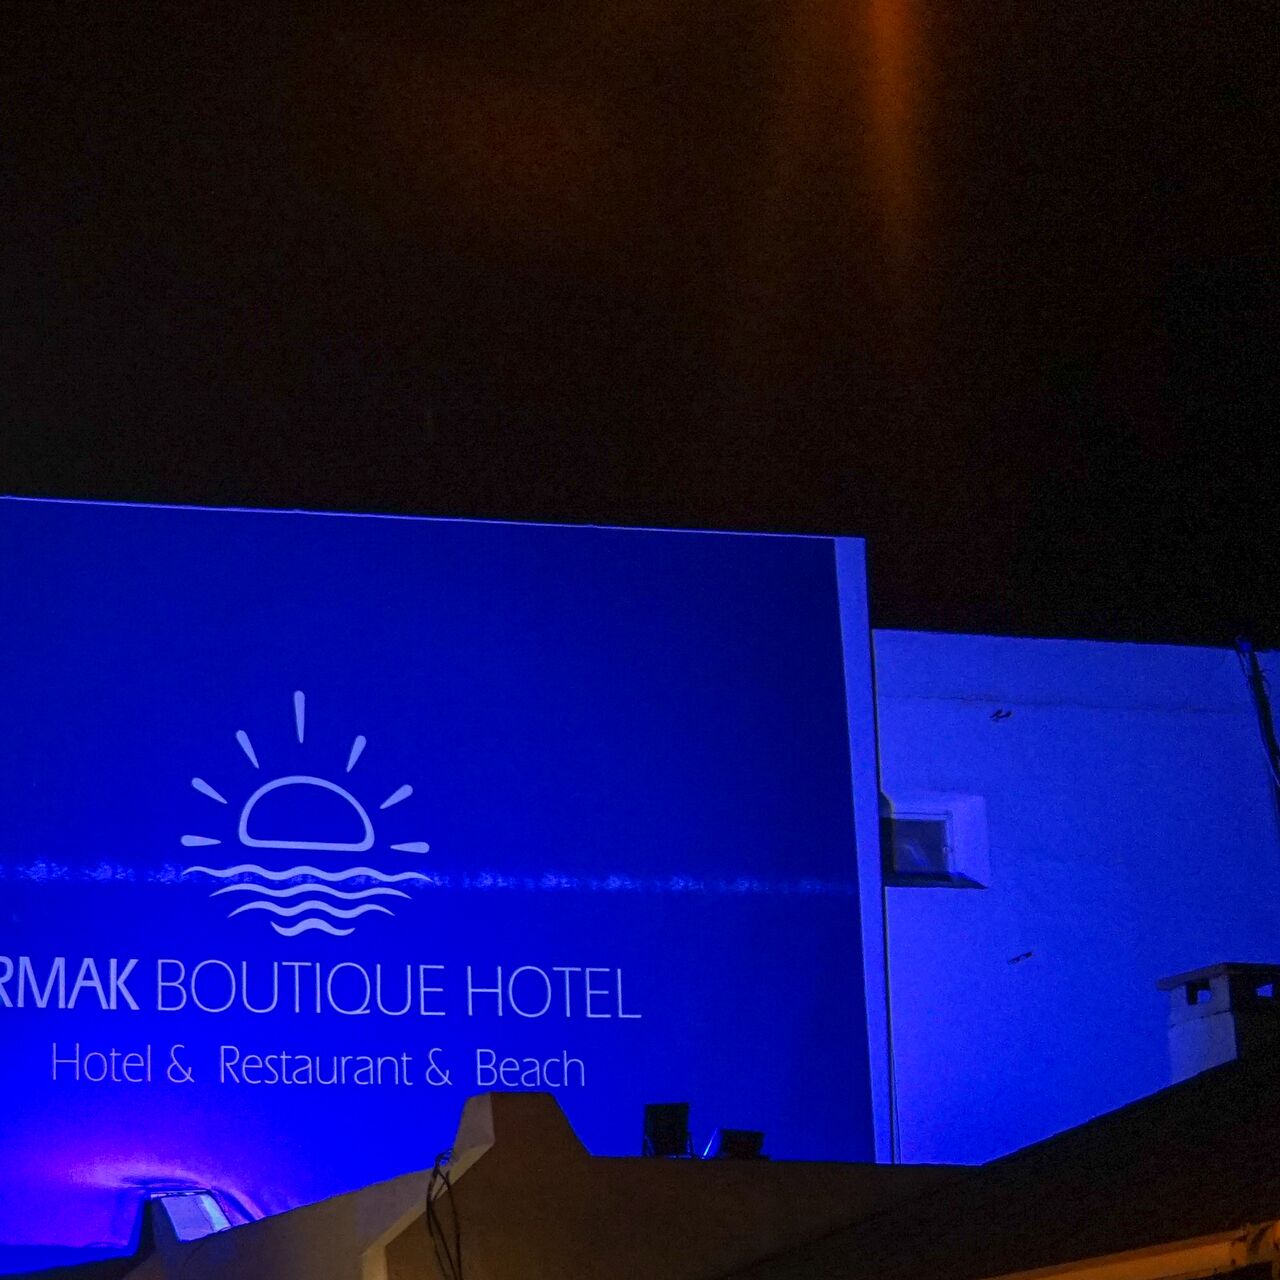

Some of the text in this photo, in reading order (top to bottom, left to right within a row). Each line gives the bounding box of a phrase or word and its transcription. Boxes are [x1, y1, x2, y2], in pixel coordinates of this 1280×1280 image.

[157, 958, 446, 1016] BOUTIQUE
[467, 965, 642, 1018] HOTEL
[52, 1042, 586, 1088] Hotel & Restaurant & Beach
